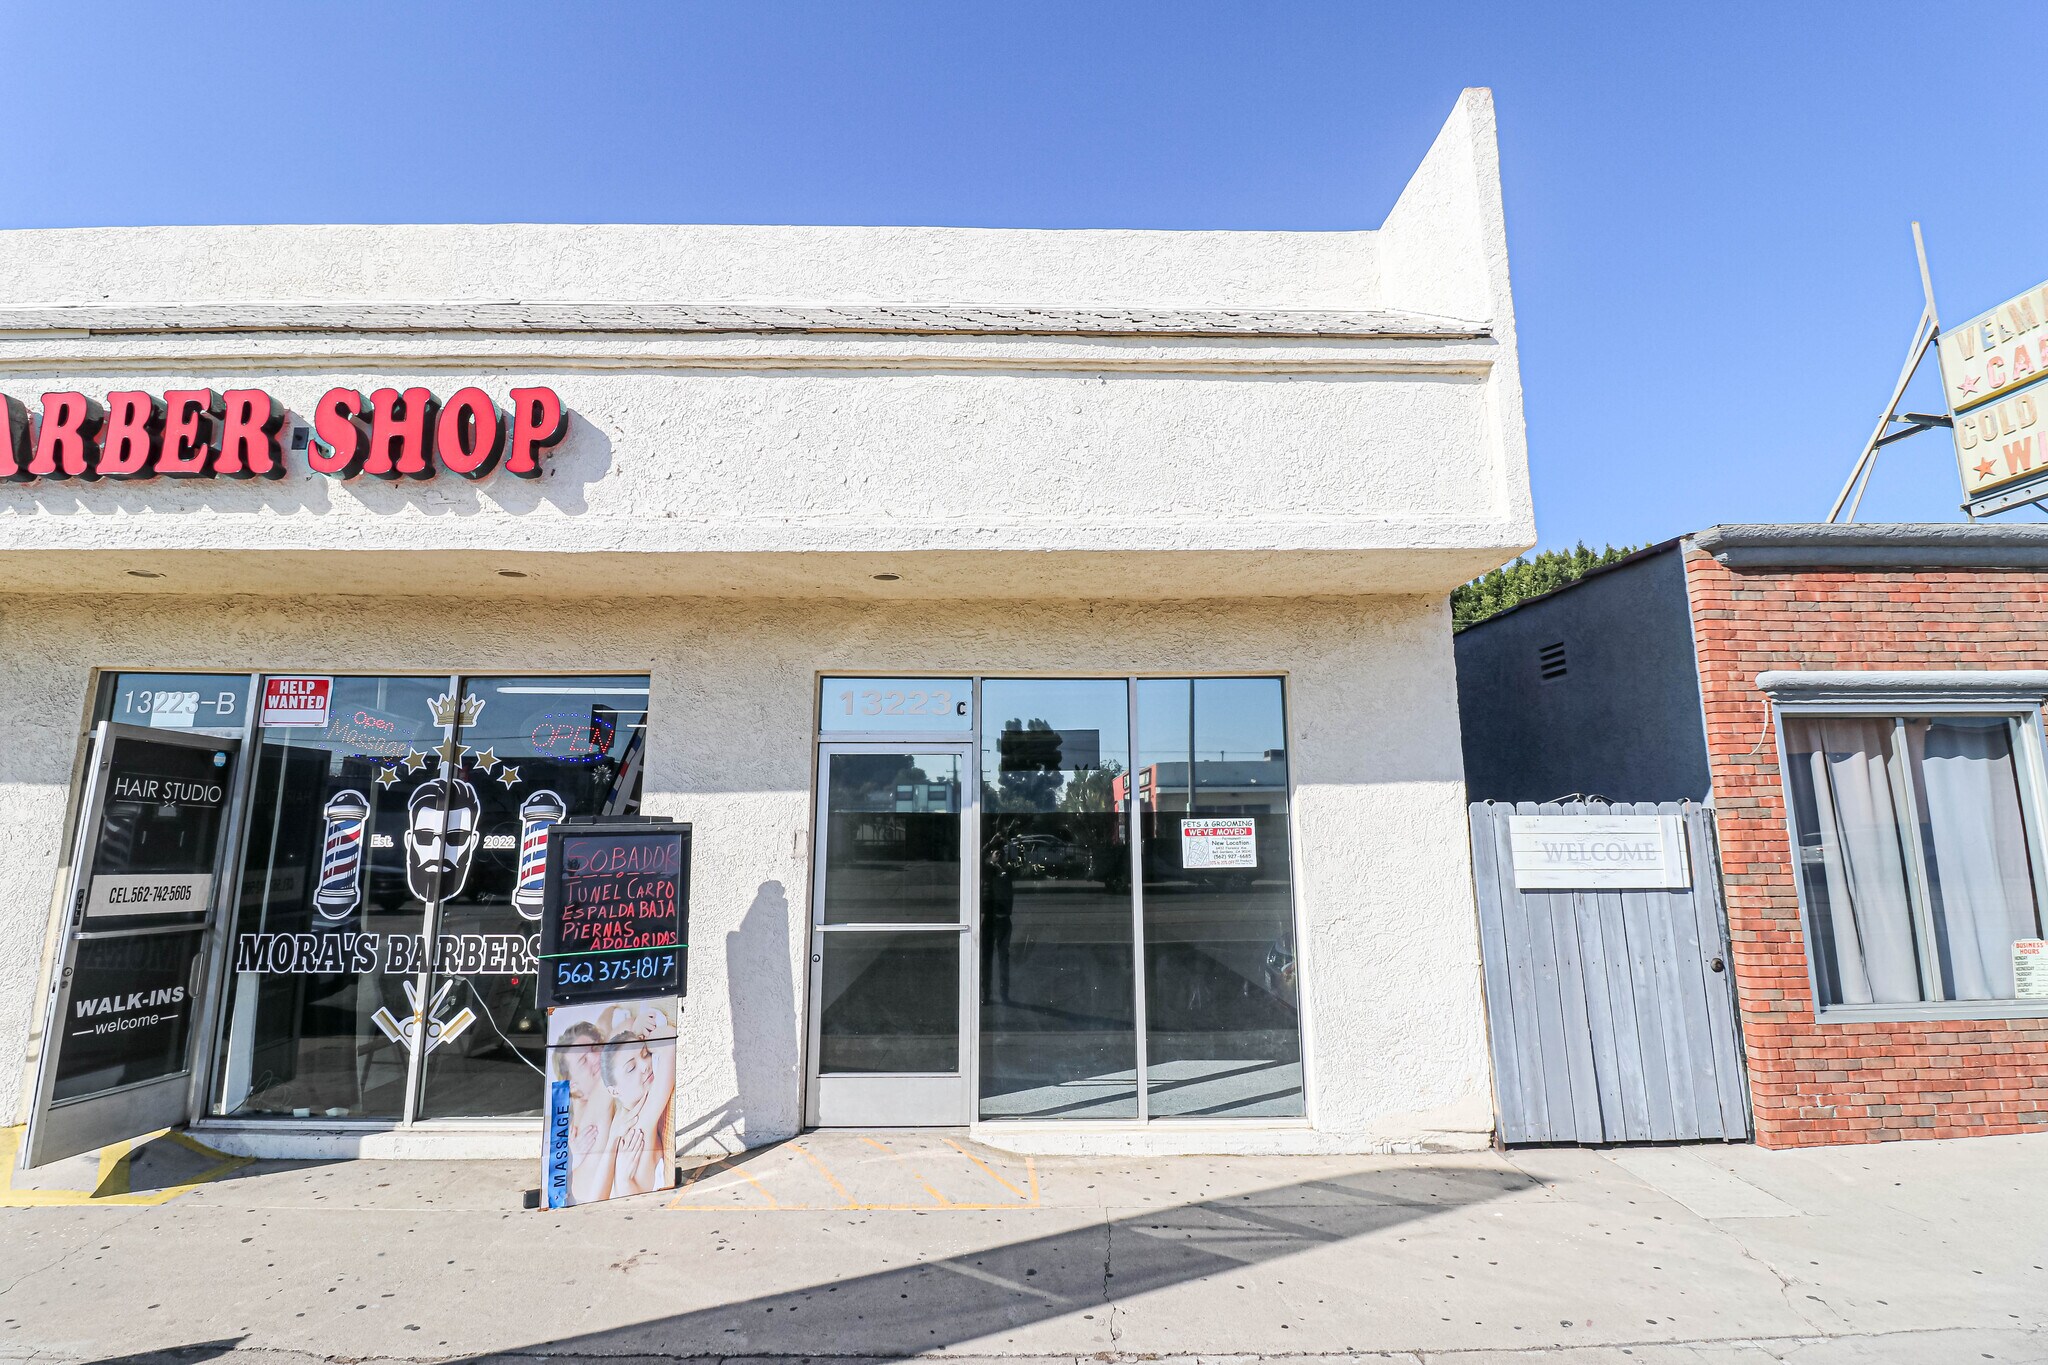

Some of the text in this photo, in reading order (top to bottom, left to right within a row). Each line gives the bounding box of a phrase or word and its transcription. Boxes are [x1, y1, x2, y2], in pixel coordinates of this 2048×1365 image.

[308, 386, 566, 479] SHOP
[1958, 393, 2038, 450] COLD
[279, 681, 316, 695] HELP
[125, 690, 235, 715] 13223-B
[268, 695, 325, 709] WANTED
[839, 689, 952, 716] 13223
[353, 711, 394, 733] Open
[327, 718, 407, 762] Massage
[531, 723, 614, 753] OPEN
[115, 777, 222, 803] HAIR STUDIO
[370, 834, 516, 849] Est. 2022
[1188, 828, 1214, 836] WE'VE
[565, 842, 679, 873] SOBADOR
[1542, 841, 1657, 862] WELCOME
[75, 891, 83, 917] PULL
[562, 899, 676, 921] ESPALDA BAJA
[236, 932, 380, 974] MORA'S
[590, 931, 677, 950] ADOLORIDAS
[558, 962, 594, 985] 562
[76, 986, 185, 1018] WALK-INS
[95, 1013, 159, 1035] welcome
[553, 1104, 570, 1188] MASSAGE
